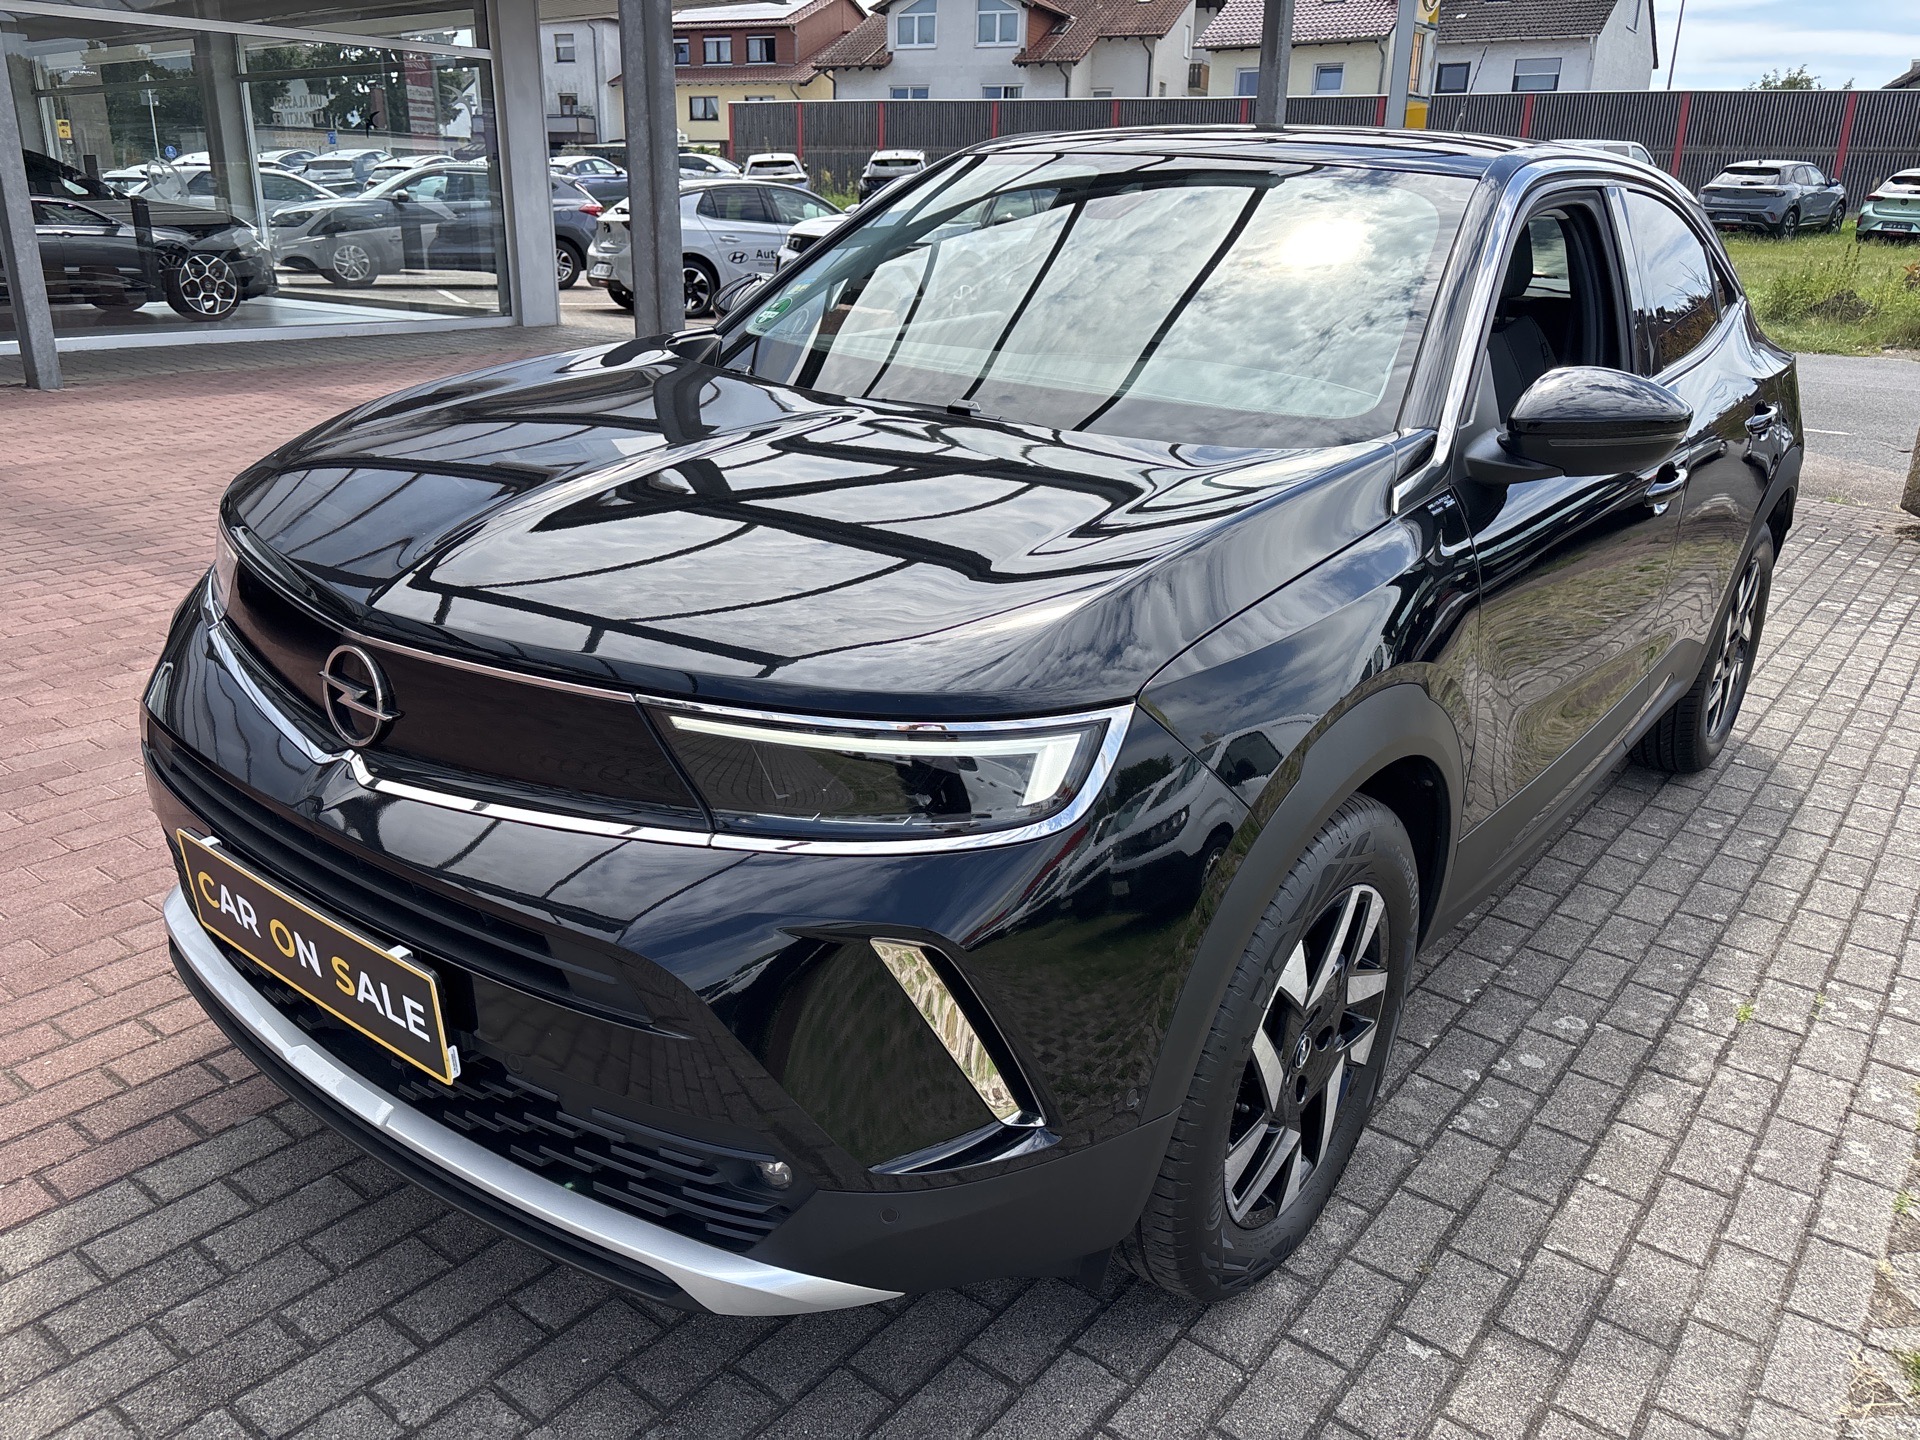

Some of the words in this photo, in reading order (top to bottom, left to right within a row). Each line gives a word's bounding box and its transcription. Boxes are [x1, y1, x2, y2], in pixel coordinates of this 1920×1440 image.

[756, 249, 777, 259] Aut
[197, 871, 262, 938] CAR
[269, 918, 323, 978] ON
[331, 956, 431, 1043] SALE
